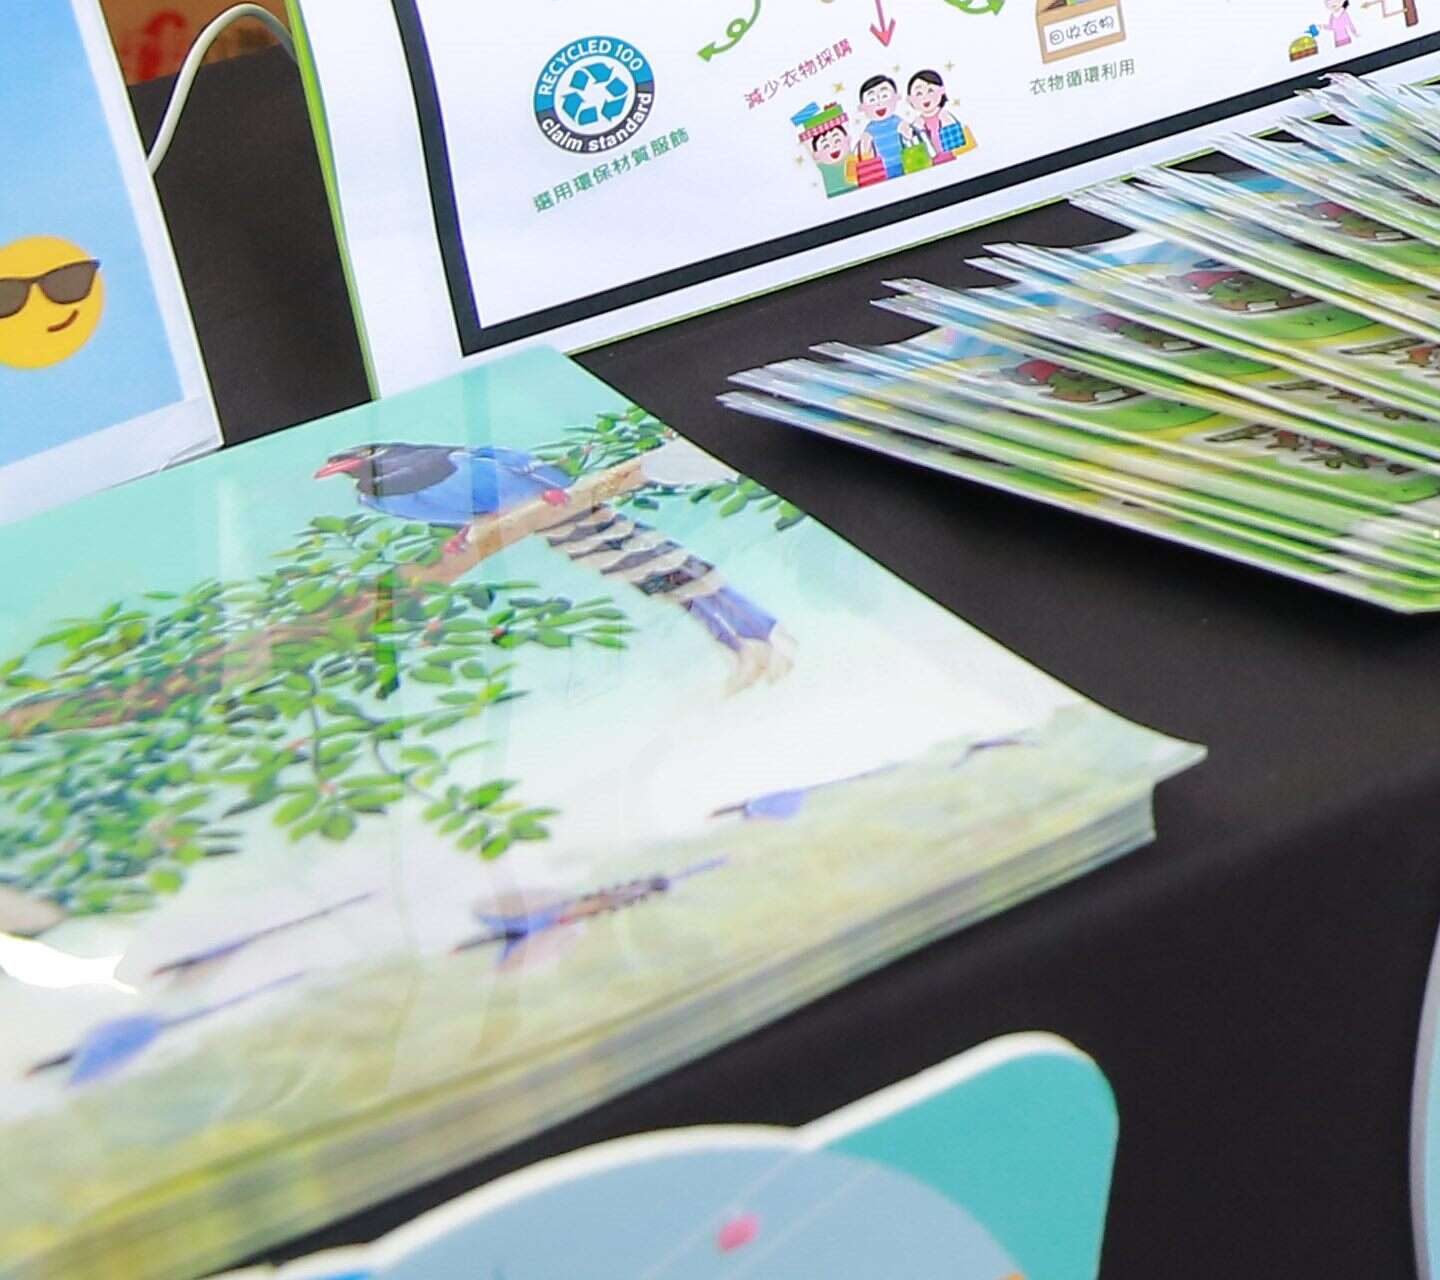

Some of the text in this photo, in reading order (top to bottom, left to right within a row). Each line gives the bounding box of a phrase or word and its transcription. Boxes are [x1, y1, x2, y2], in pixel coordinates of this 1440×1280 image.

[1049, 16, 1115, 45] 回收衣物
[538, 39, 643, 96] RECYCLED 100
[744, 39, 853, 109] 減少衣物採購
[1029, 58, 1135, 95] 衣物循環利用
[541, 92, 652, 151] claim standard
[533, 128, 690, 212] 選用環保材質服飾
